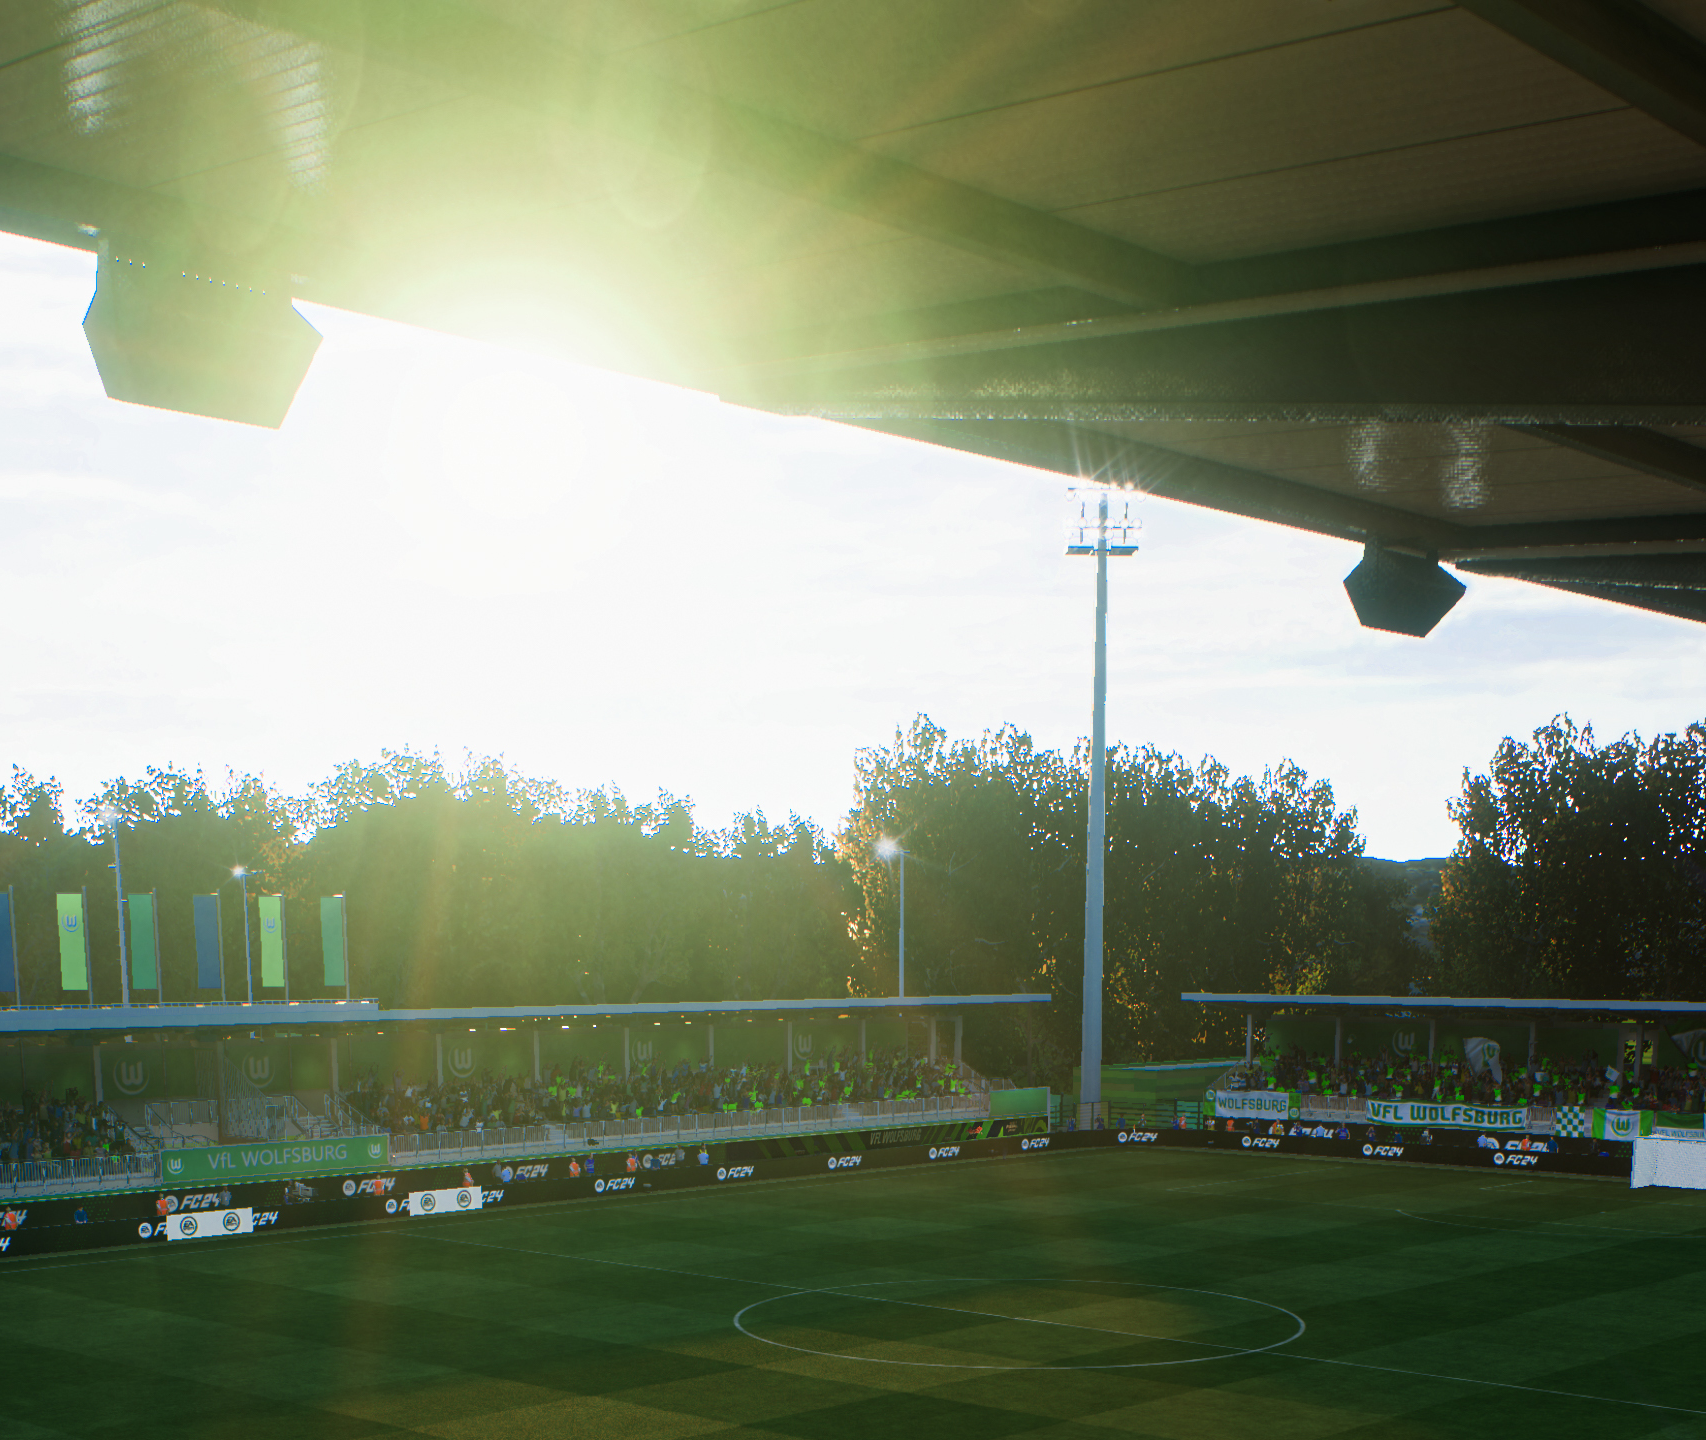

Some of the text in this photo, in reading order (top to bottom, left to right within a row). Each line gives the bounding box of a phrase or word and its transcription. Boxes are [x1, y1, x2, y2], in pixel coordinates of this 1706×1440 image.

[1217, 1097, 1287, 1114] WOLFSBURG
[1370, 1102, 1523, 1126] VFL WOLFSBURG
[882, 1128, 922, 1145] WOLFSBURG
[207, 1144, 348, 1170] VfL WOLFSBURG
[1372, 1145, 1405, 1157] FC24
[1504, 1153, 1539, 1167] FC24
[726, 1165, 755, 1180] FC24
[606, 1177, 636, 1192] FC24
